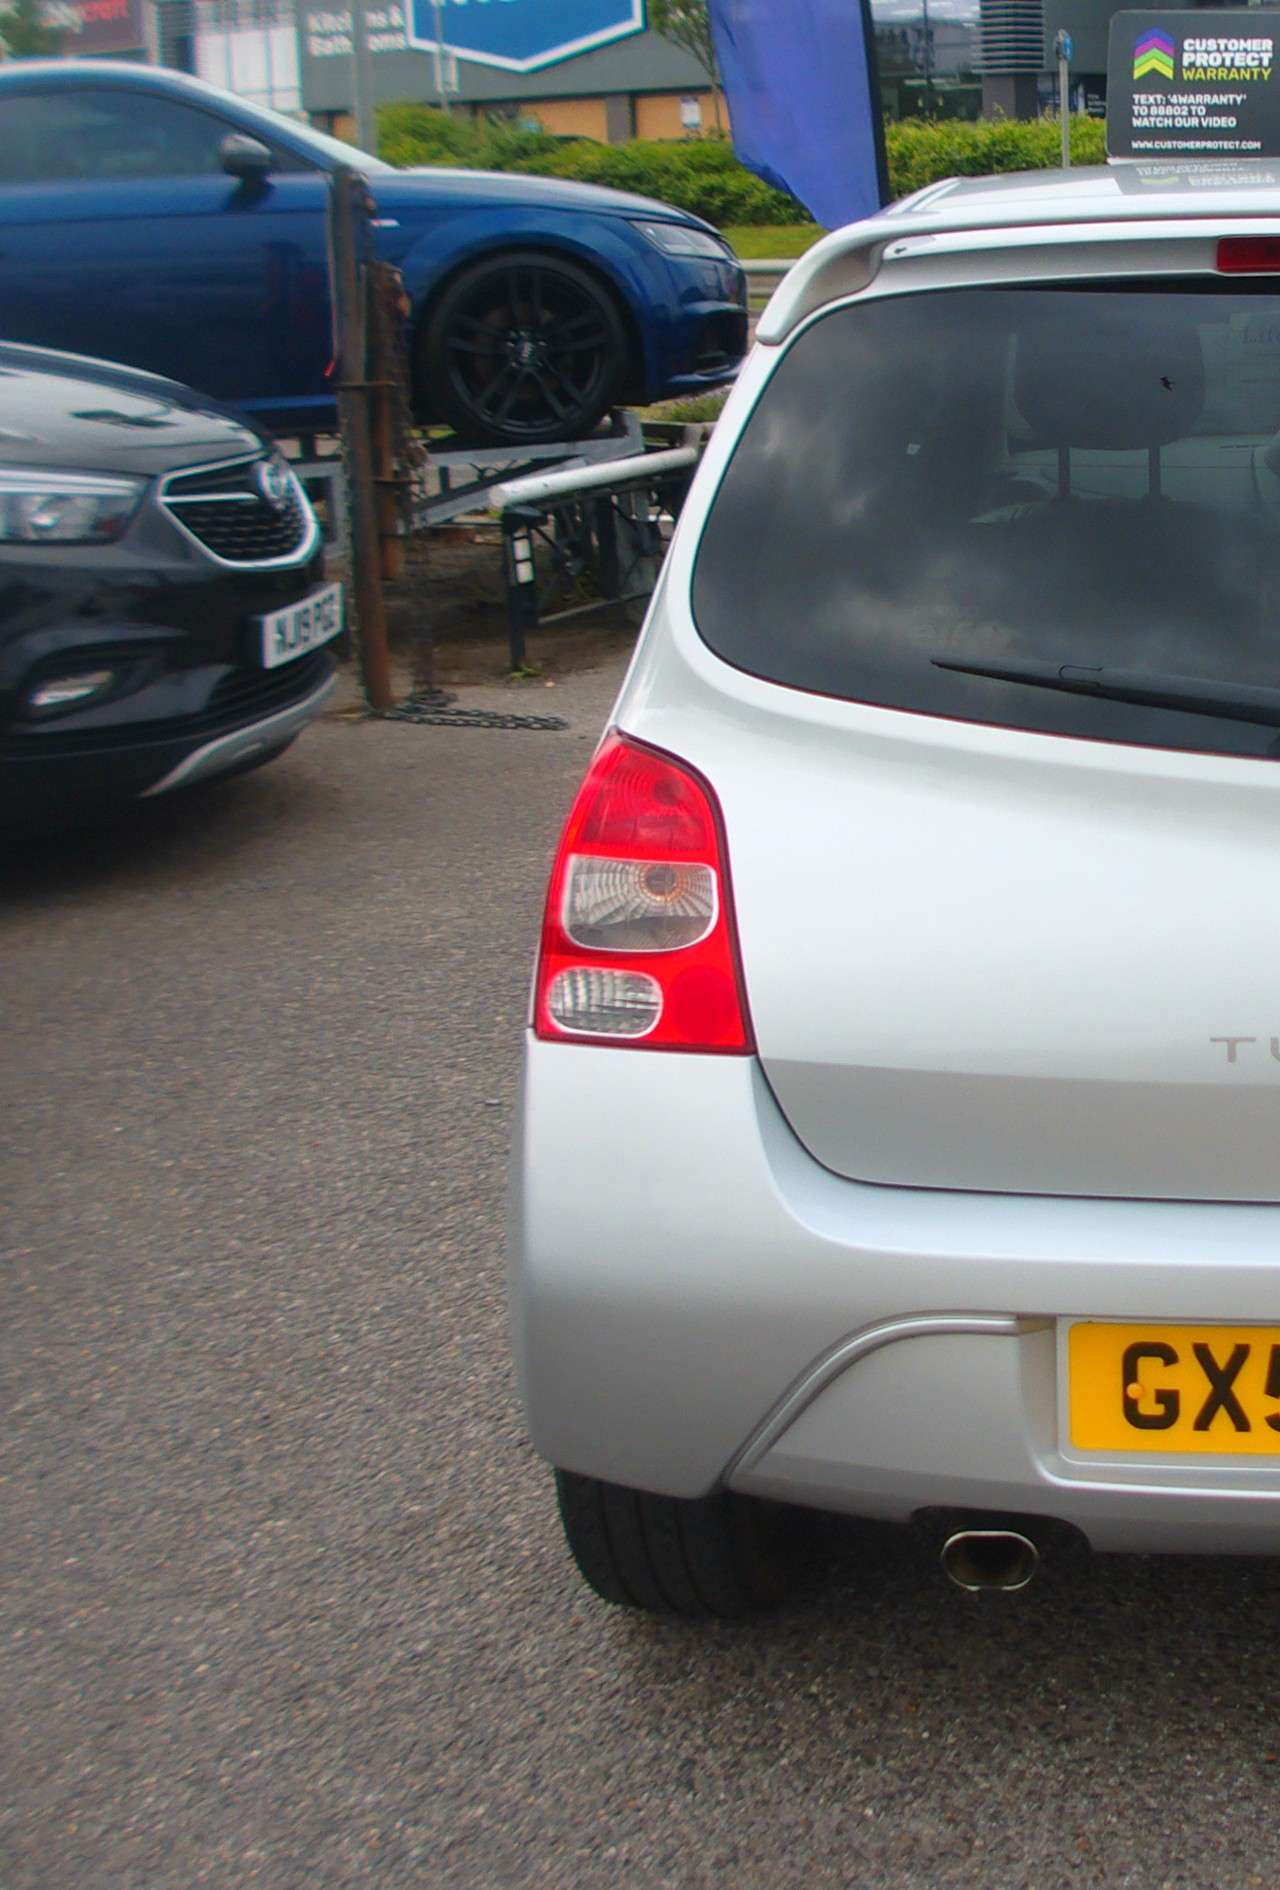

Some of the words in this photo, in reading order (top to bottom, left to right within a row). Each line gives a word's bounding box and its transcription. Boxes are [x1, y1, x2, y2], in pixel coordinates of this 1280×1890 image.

[1183, 38, 1273, 51] CUSTOMER
[1182, 52, 1273, 67] PROTECT
[1182, 67, 1272, 81] WARRANTY
[1132, 94, 1166, 105] TEXT:
[1132, 106, 1148, 116] TO
[1150, 106, 1189, 116] 88802
[1190, 106, 1206, 116] TO
[1132, 117, 1172, 127] WATCH
[1174, 117, 1199, 127] OUR
[1201, 117, 1237, 127] VIDEO
[1131, 140, 1261, 150] WWW.CUSTOMERPROTECT.COM
